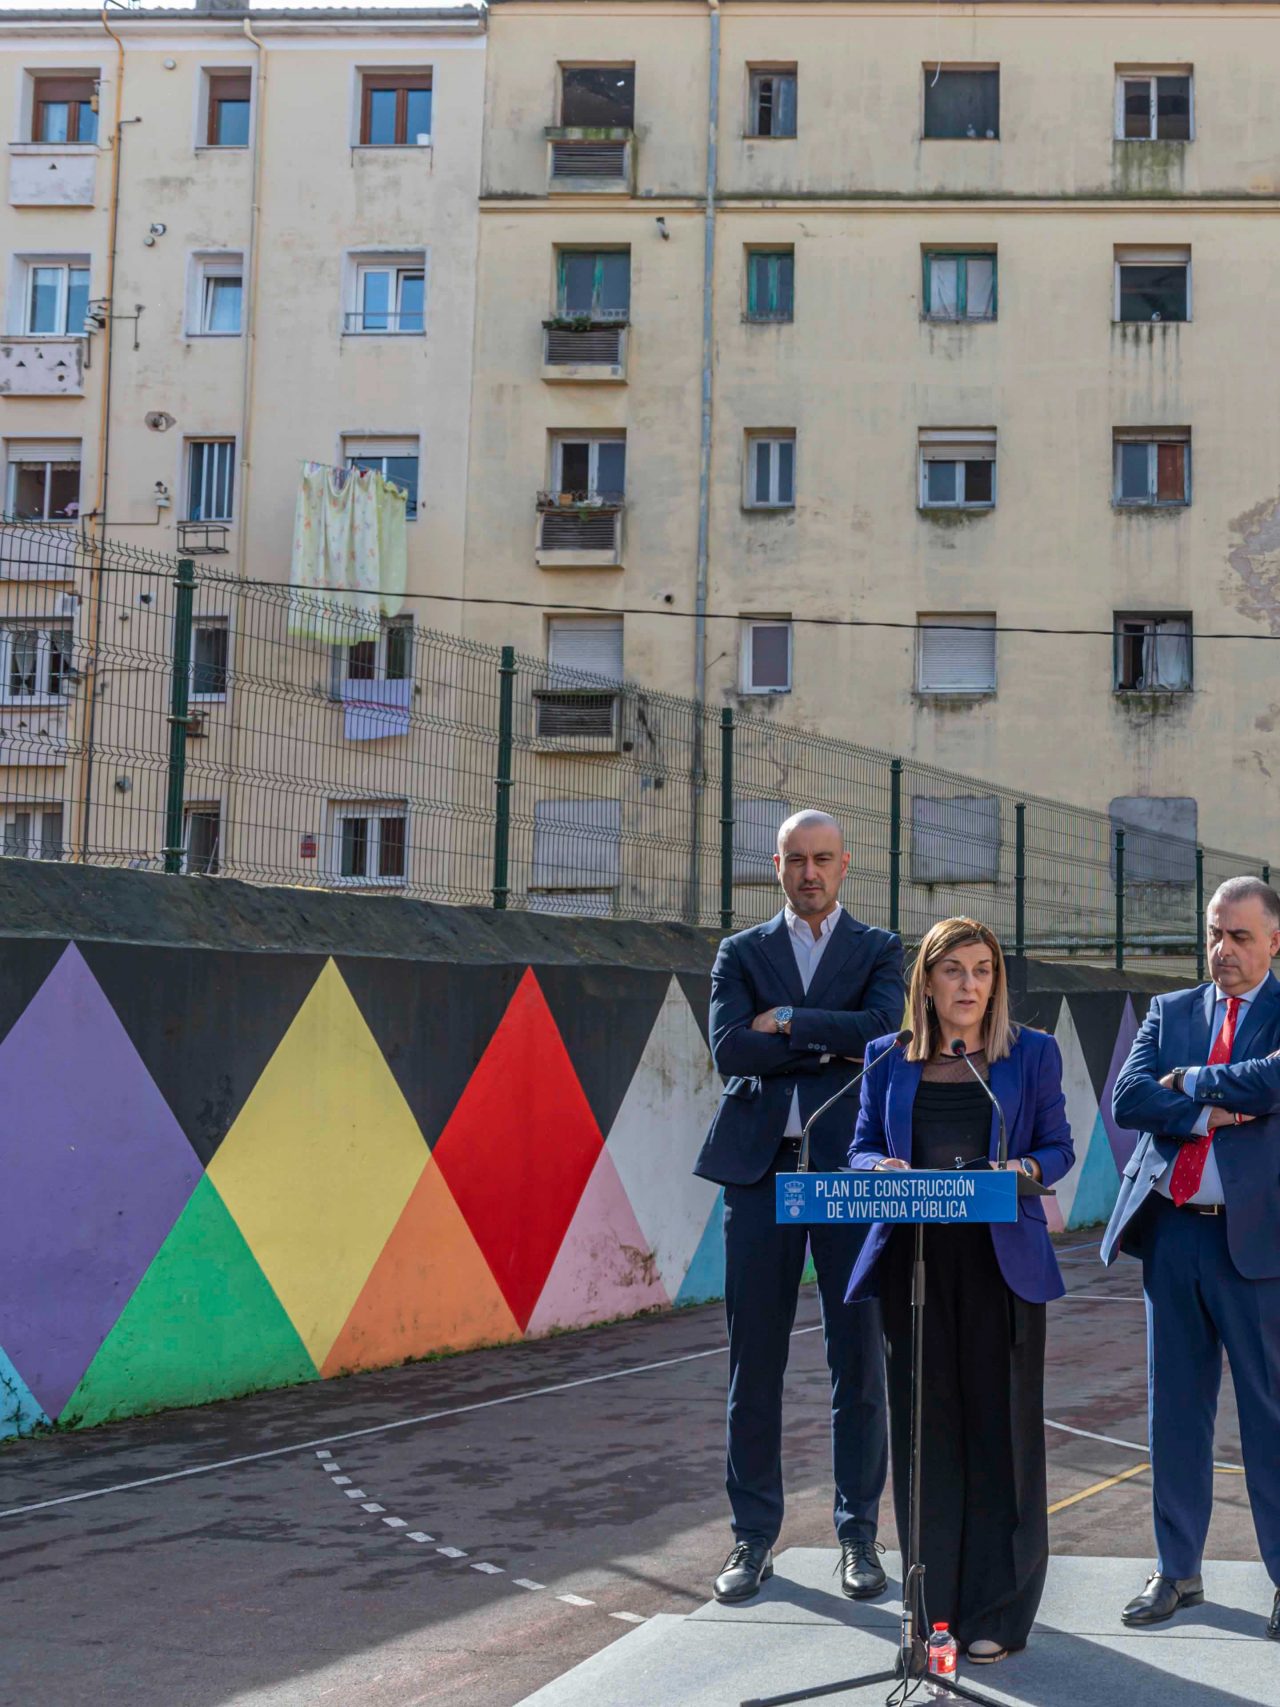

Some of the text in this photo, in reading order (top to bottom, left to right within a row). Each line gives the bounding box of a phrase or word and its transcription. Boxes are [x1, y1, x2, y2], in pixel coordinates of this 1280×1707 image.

[815, 1175, 975, 1197] PLAN DE CONSTRUCCIÓN
[827, 1197, 968, 1218] DE VIVIENDA PÚBLICA
